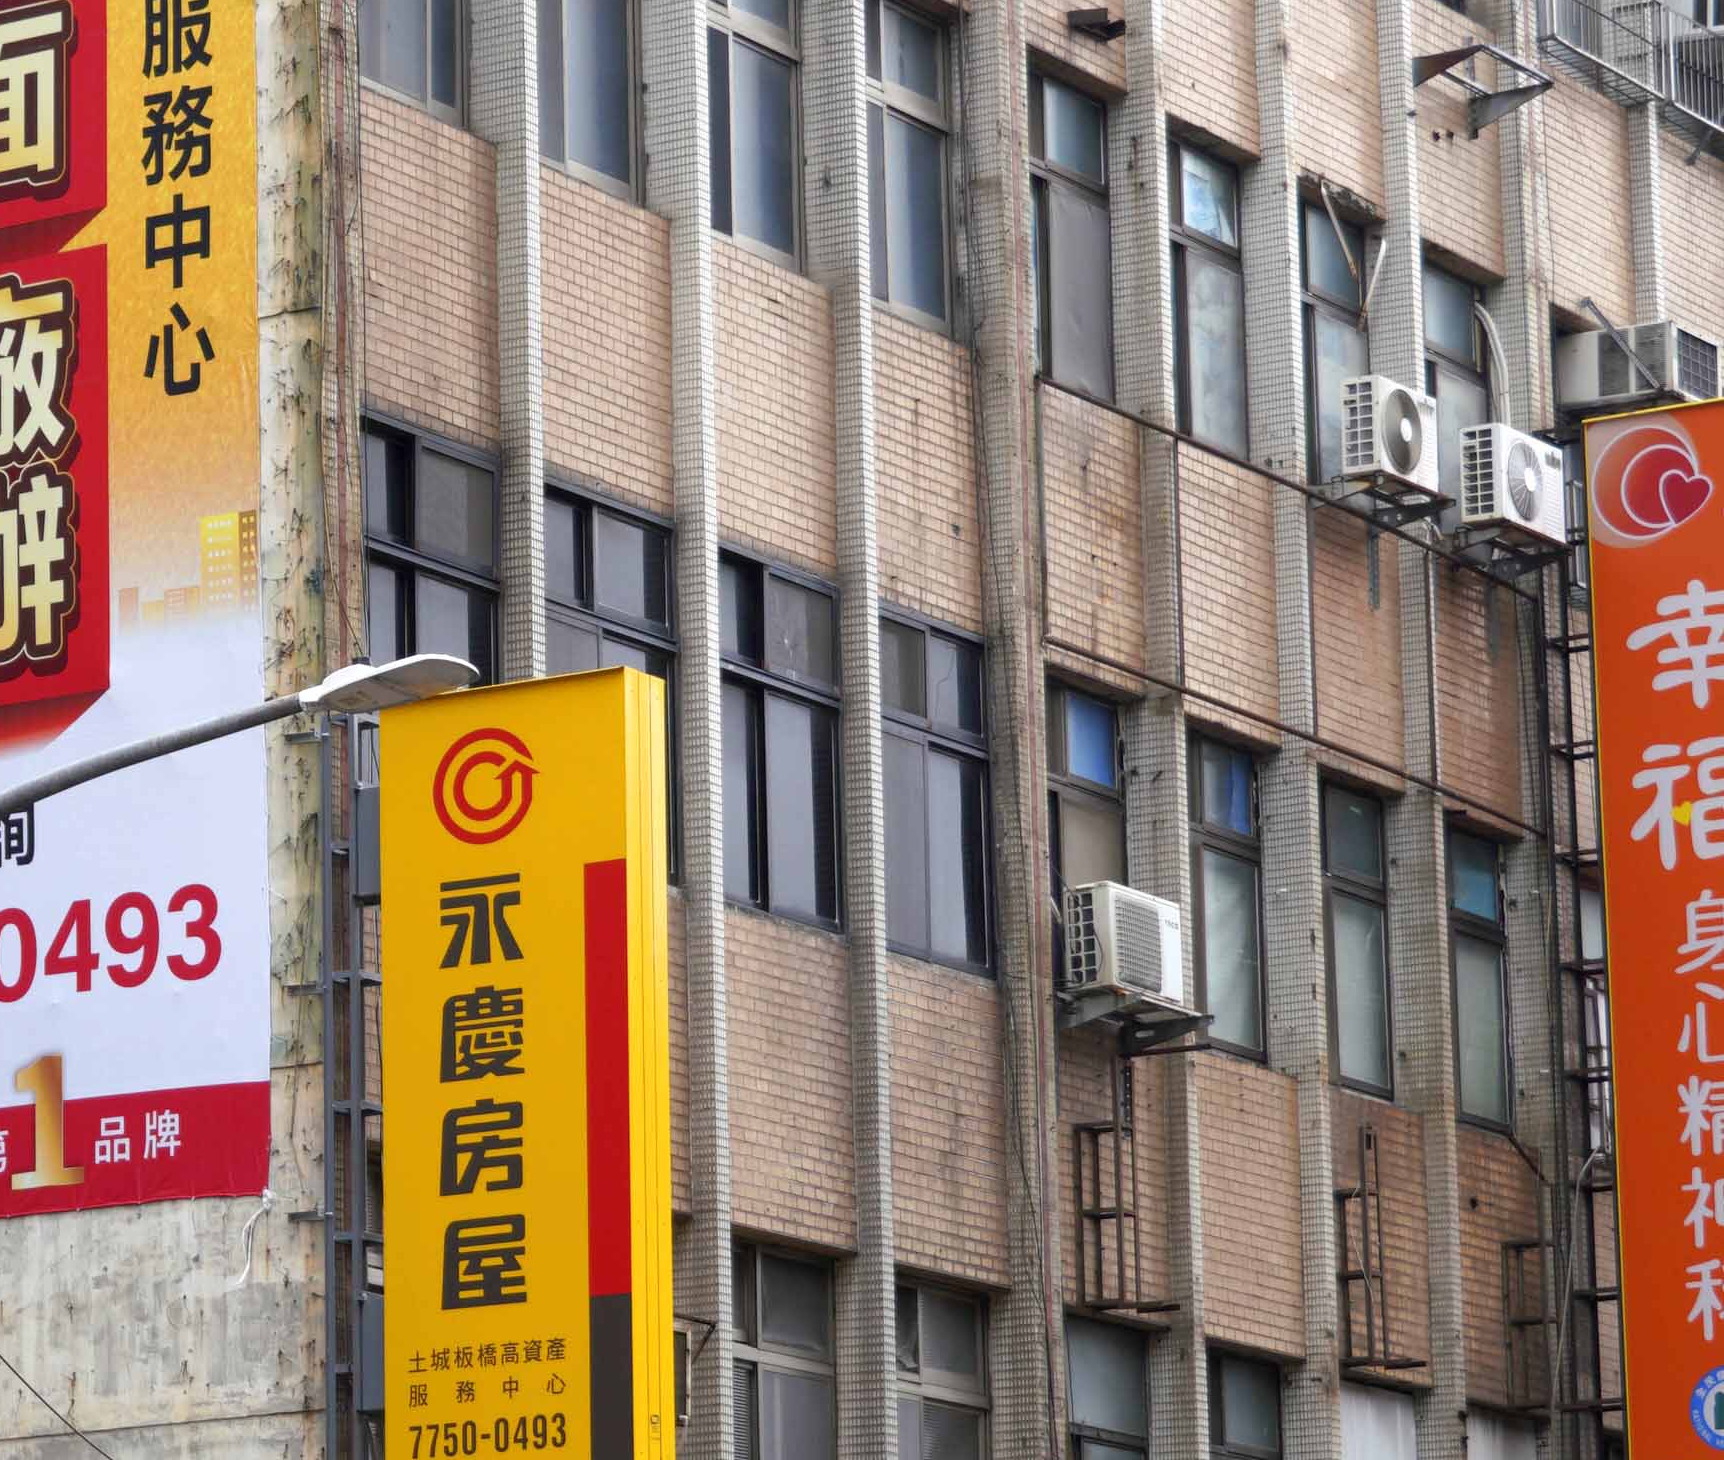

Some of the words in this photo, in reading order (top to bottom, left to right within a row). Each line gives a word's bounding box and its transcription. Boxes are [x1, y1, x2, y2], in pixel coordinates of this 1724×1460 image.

[439, 871, 528, 1311] 永慶房屋
[407, 1337, 567, 1374] 土城板橋高資產
[408, 1372, 567, 1409] 服務中心
[408, 1411, 567, 1460] 7750-0493
